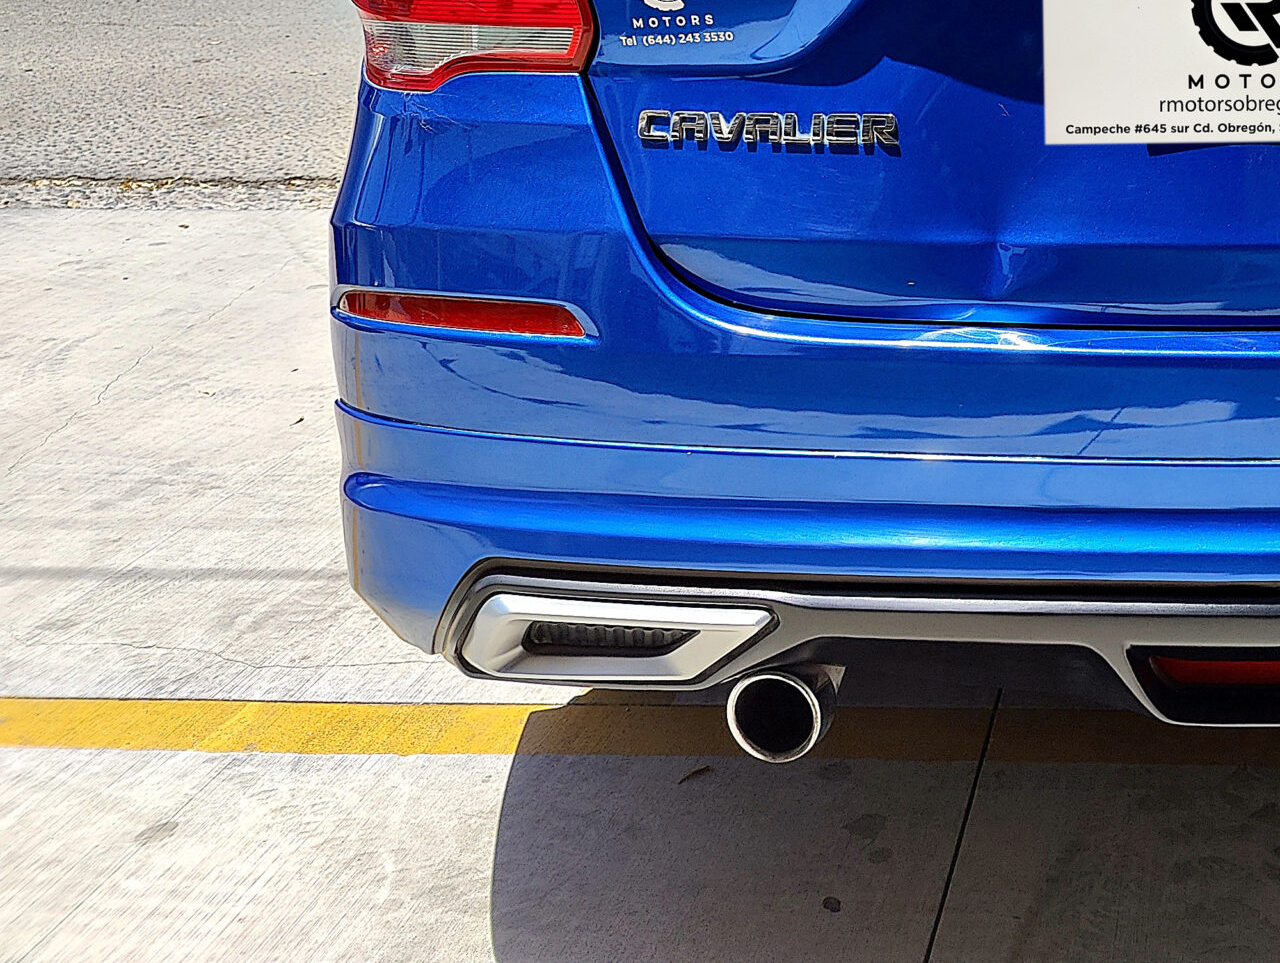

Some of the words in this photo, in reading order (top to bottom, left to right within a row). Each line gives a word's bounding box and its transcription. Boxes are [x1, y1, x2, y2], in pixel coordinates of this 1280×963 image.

[632, 14, 714, 29] MOTORS
[619, 36, 637, 46] Tel
[642, 34, 676, 46] (644)
[678, 33, 701, 44] 243
[703, 31, 734, 42] 3530
[638, 110, 900, 145] CAVALIER
[1065, 124, 1131, 136] Campeche
[1134, 124, 1167, 134] #645
[1170, 125, 1190, 134] sur
[1193, 123, 1214, 133] Cd.
[1217, 121, 1275, 135] Obregón,
